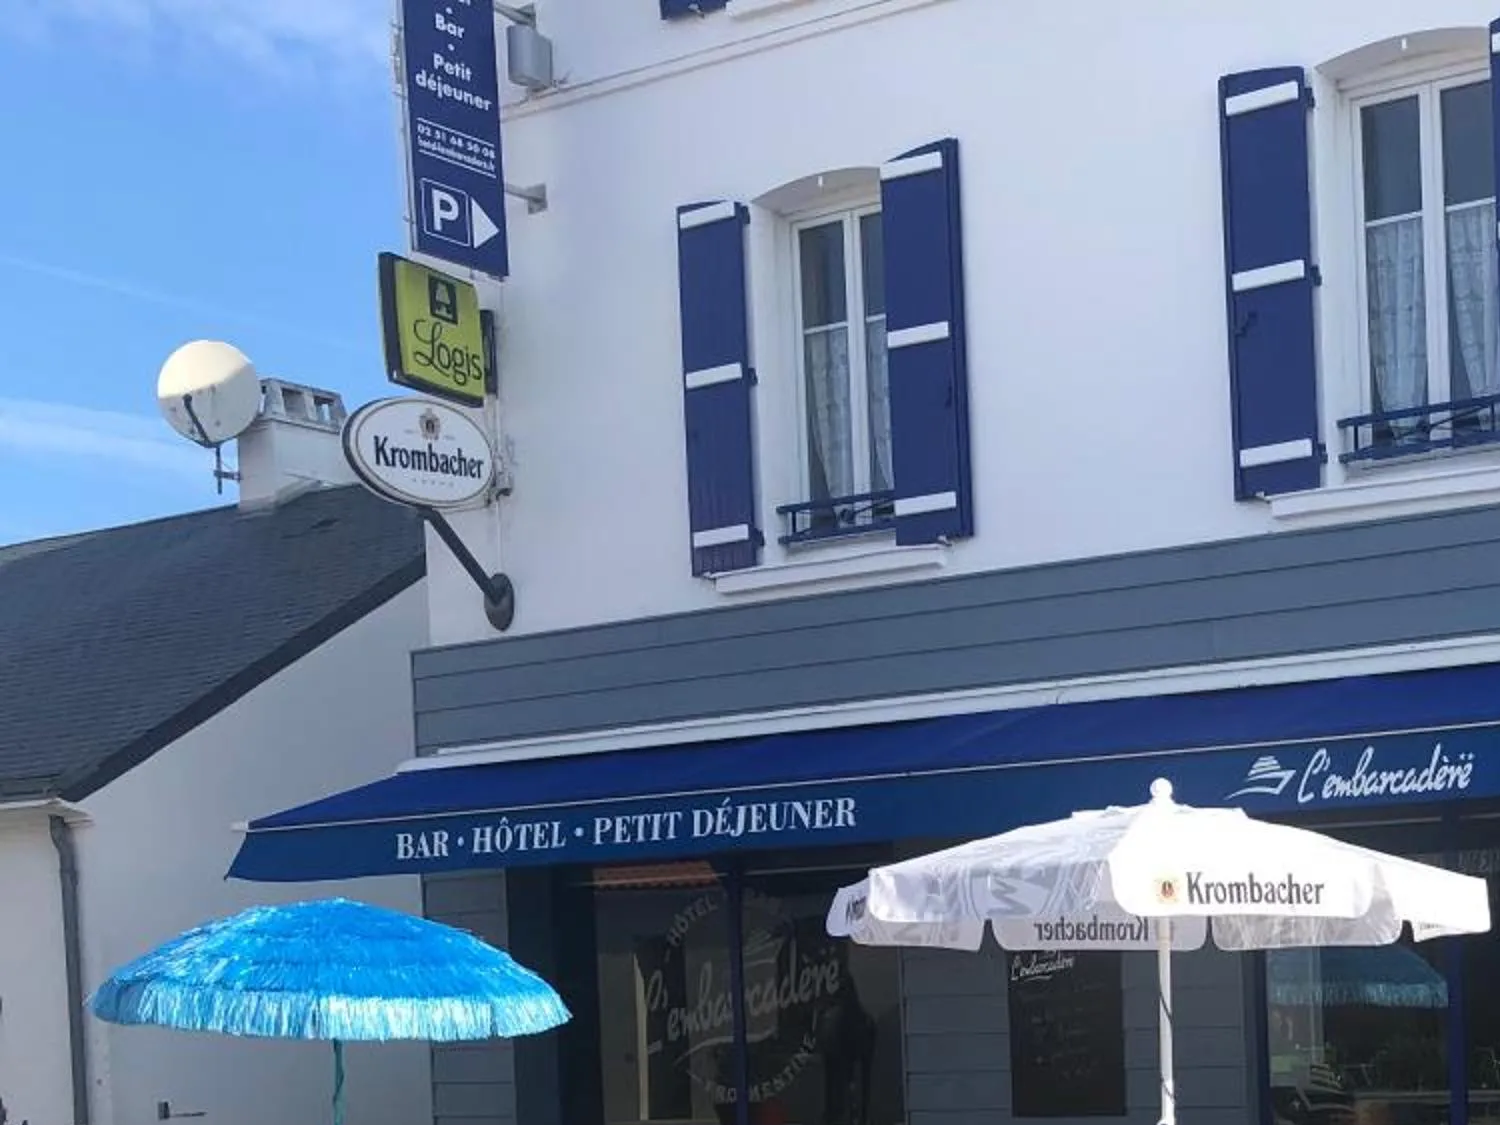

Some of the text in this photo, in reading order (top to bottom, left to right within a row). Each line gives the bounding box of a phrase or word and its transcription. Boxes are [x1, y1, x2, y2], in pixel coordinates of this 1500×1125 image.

[435, 13, 464, 39] Bar
[434, 53, 473, 82] Petit
[415, 70, 492, 111] déjeuner
[431, 188, 459, 231] P
[413, 318, 482, 386] Logis
[373, 435, 484, 479] Krombacher
[396, 798, 858, 860] BAR HÔTEL PETIT DÉJEUNER
[1185, 871, 1325, 905] Krombacher
